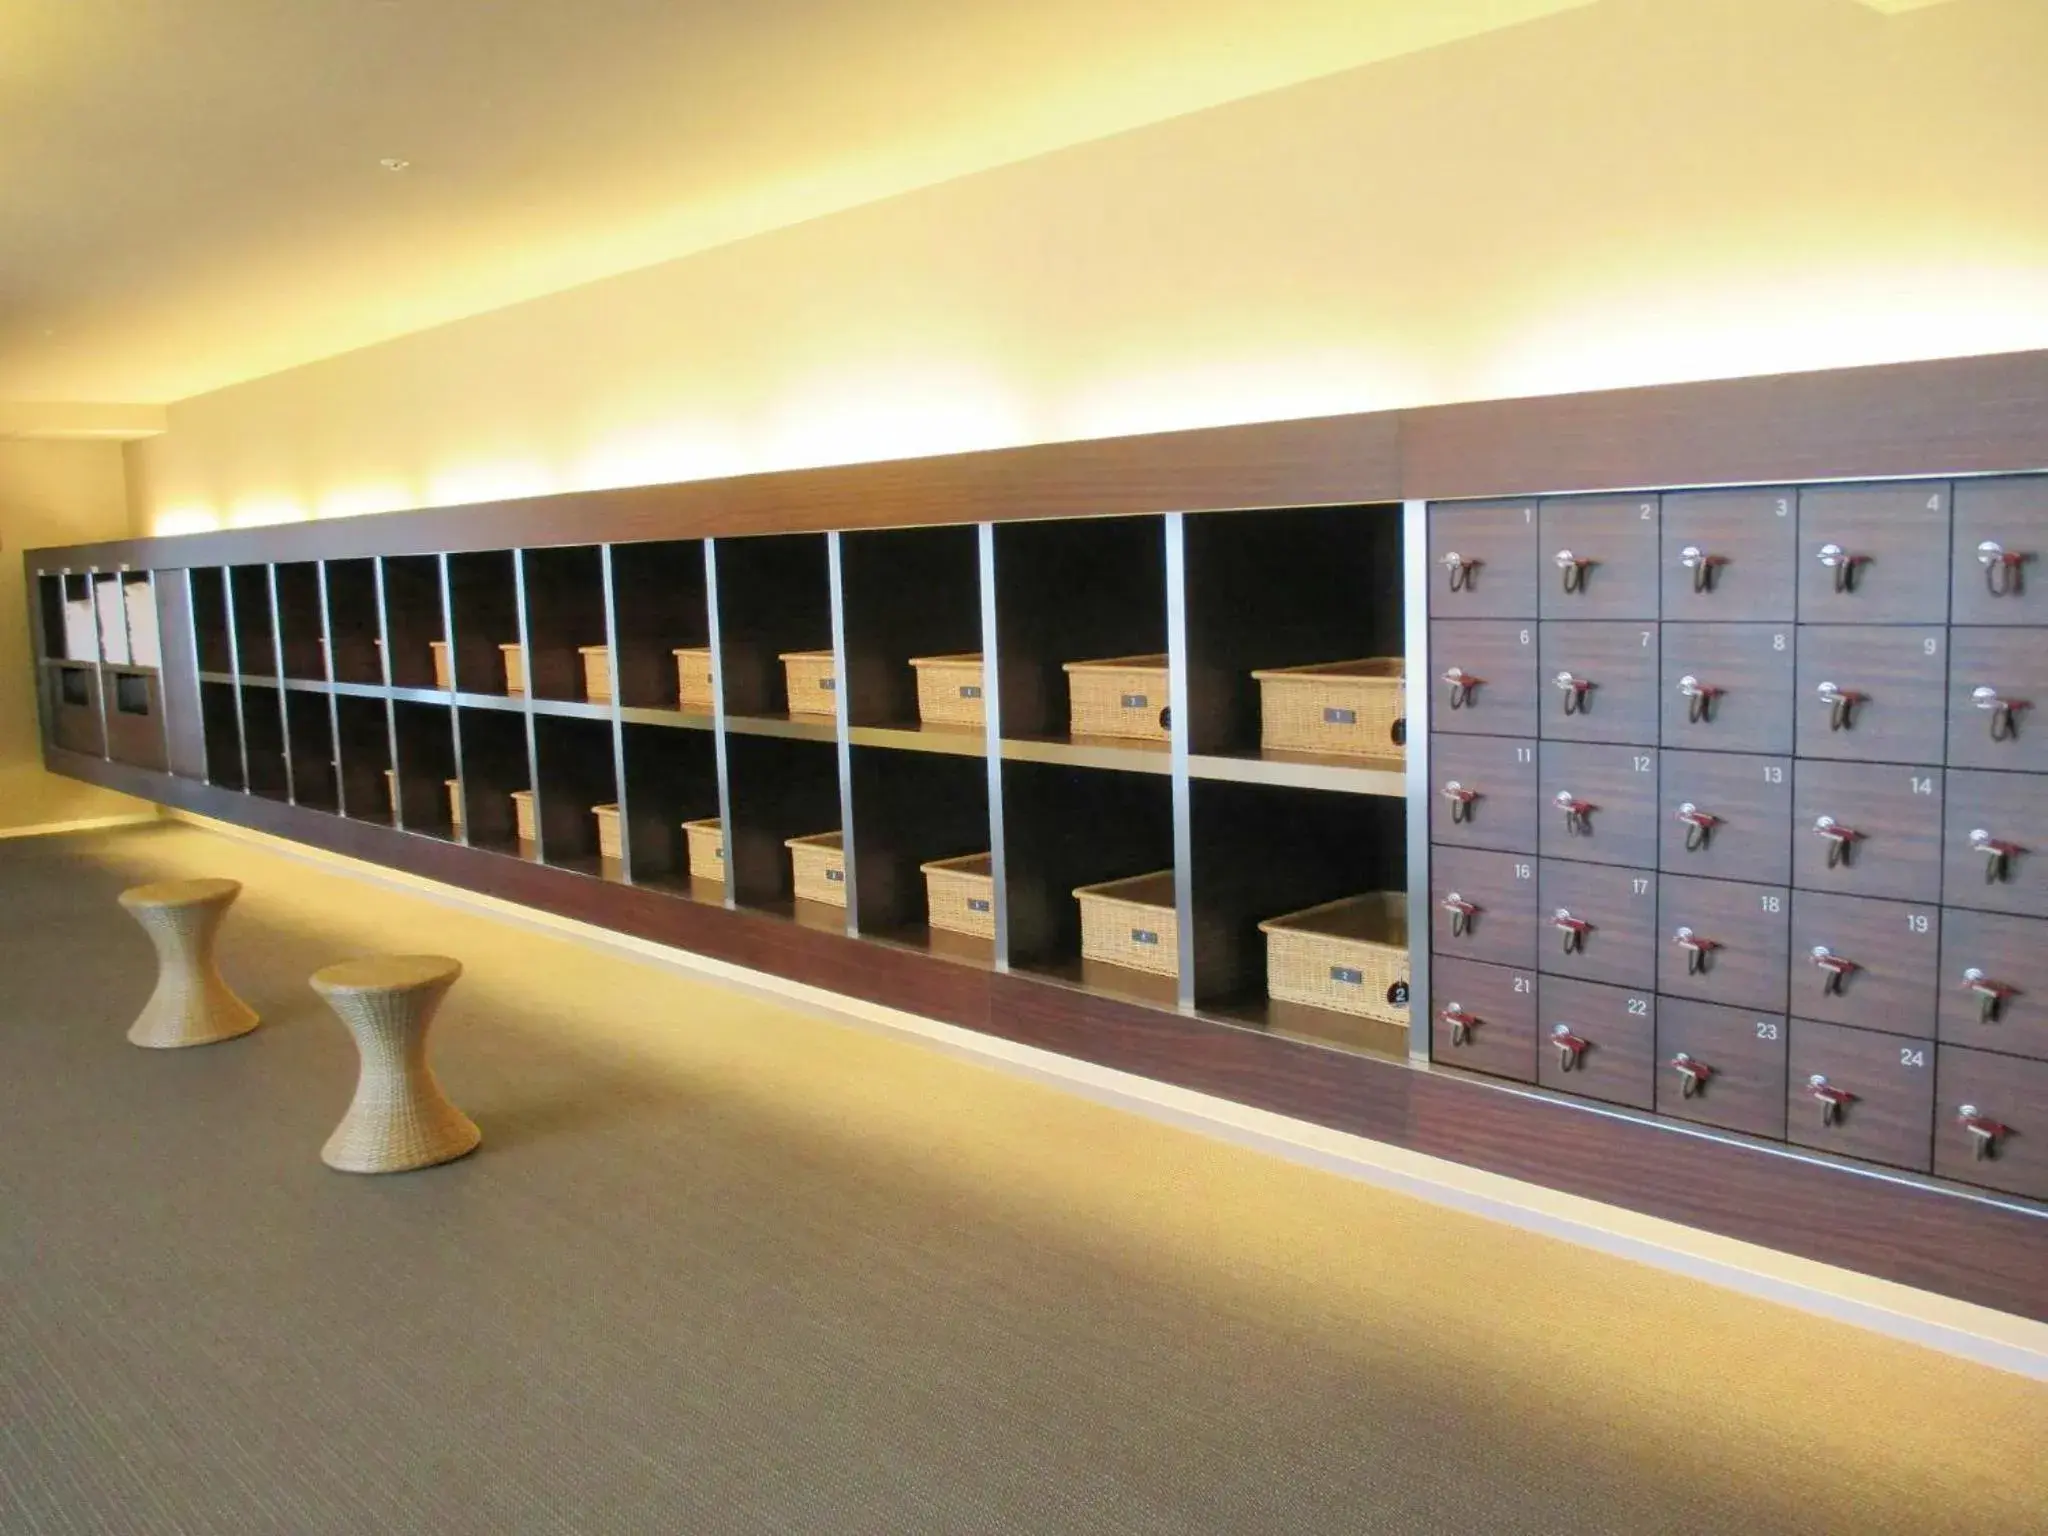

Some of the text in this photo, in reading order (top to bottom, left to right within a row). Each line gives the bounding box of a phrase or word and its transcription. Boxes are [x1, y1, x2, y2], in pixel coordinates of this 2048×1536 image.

[1775, 498, 1788, 517] 3
[1926, 494, 1939, 511] 4
[1524, 508, 1531, 524] 1
[1640, 503, 1651, 520] 2
[1519, 629, 1530, 645] 6
[1640, 631, 1651, 647] 7
[1773, 633, 1786, 651] 8
[1923, 638, 1937, 655] 9
[1517, 747, 1531, 763] 11
[1633, 756, 1651, 772] 12
[1763, 766, 1782, 783] 13
[1910, 777, 1932, 795] 14
[1514, 863, 1531, 879] 16
[1633, 878, 1649, 895] 17
[1761, 895, 1781, 913] 18
[1907, 914, 1929, 933] 19
[1514, 977, 1530, 994] 21
[1395, 987, 1406, 1003] 2
[1628, 998, 1647, 1016] 22
[1756, 1022, 1778, 1040] 23
[1900, 1048, 1924, 1067] 24
